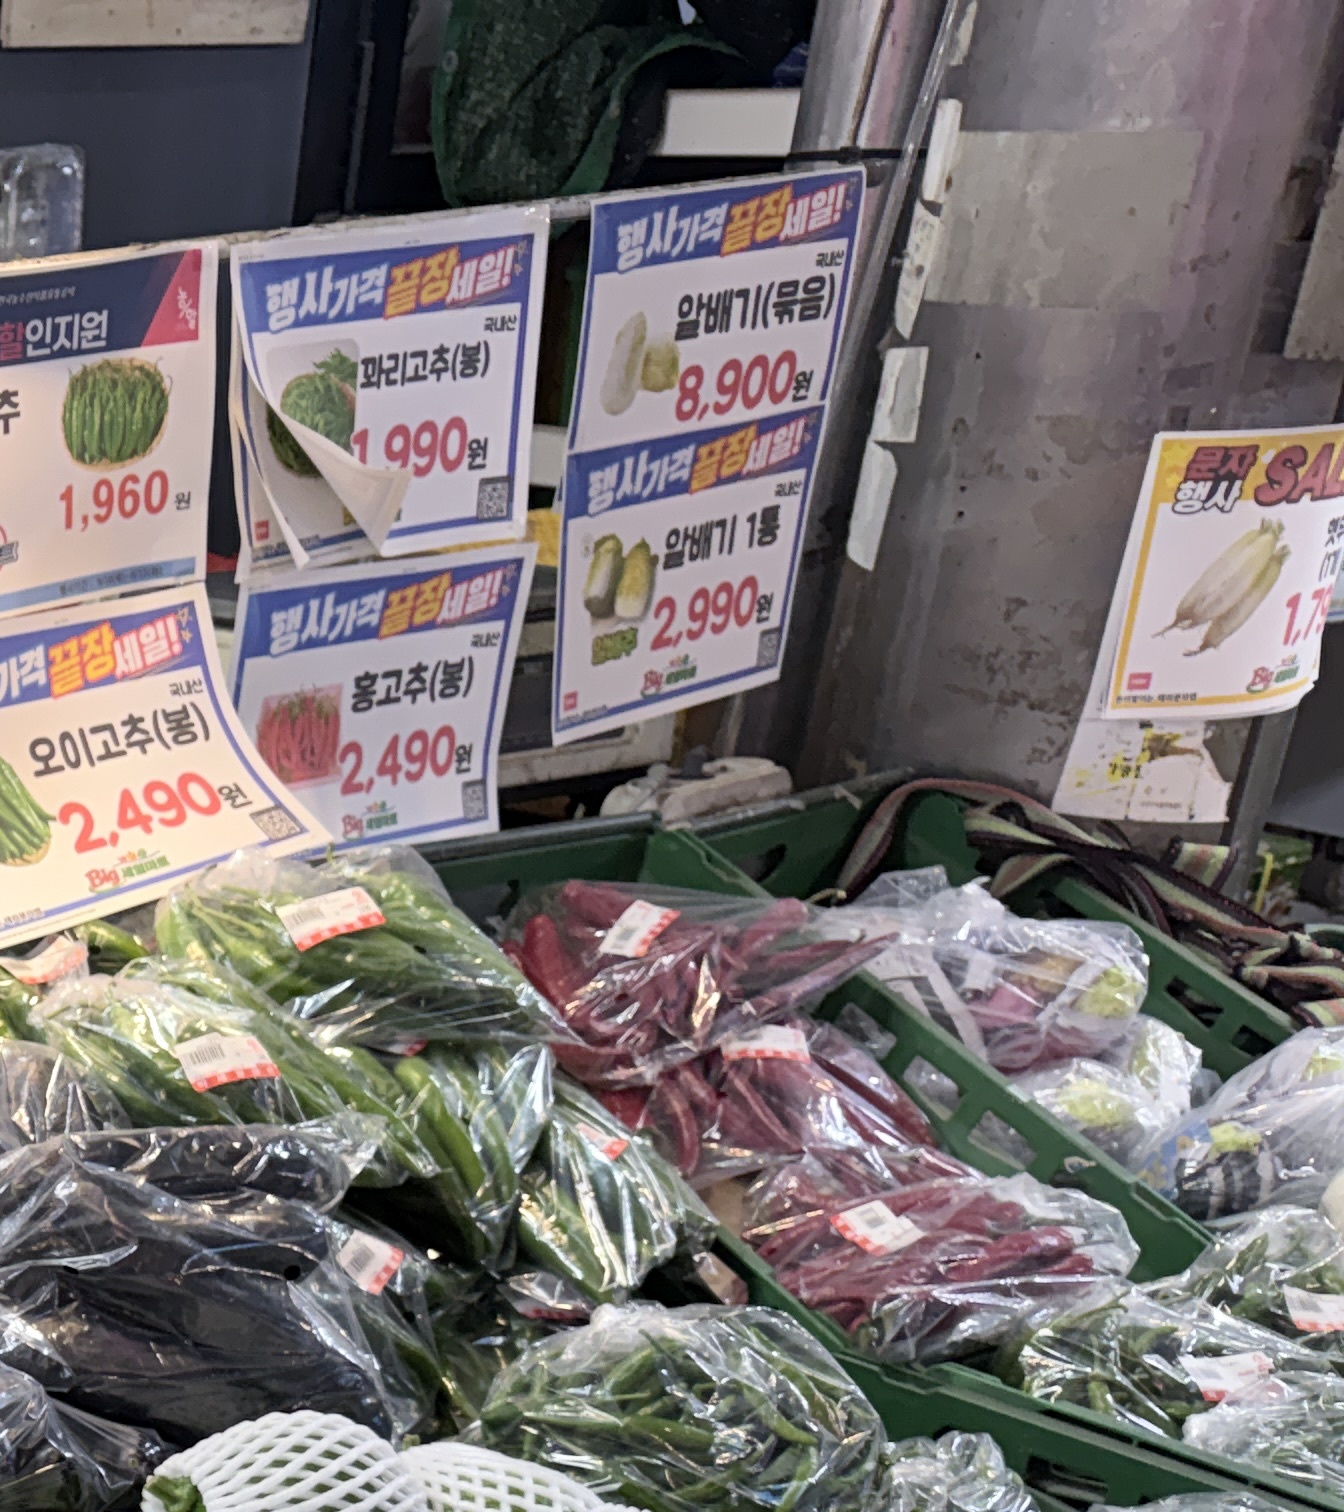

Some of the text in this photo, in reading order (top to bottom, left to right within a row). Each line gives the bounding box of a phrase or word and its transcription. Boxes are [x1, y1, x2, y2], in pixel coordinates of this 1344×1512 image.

[616, 202, 729, 274] 행사가격
[266, 264, 388, 333] 행사가격
[674, 273, 835, 341] 알배기(묶음)
[587, 443, 696, 516] 행사가격
[1186, 444, 1260, 481] 문자
[59, 470, 191, 532] 1,960 원
[1172, 479, 1242, 515] 행사
[663, 514, 736, 570] 알배기
[270, 589, 387, 658] 행사가격
[169, 679, 203, 698] 국내산
[351, 656, 475, 714] 홍고추(봉)
[28, 702, 210, 778] 오이고추(봉)
[86, 867, 120, 888] Big
